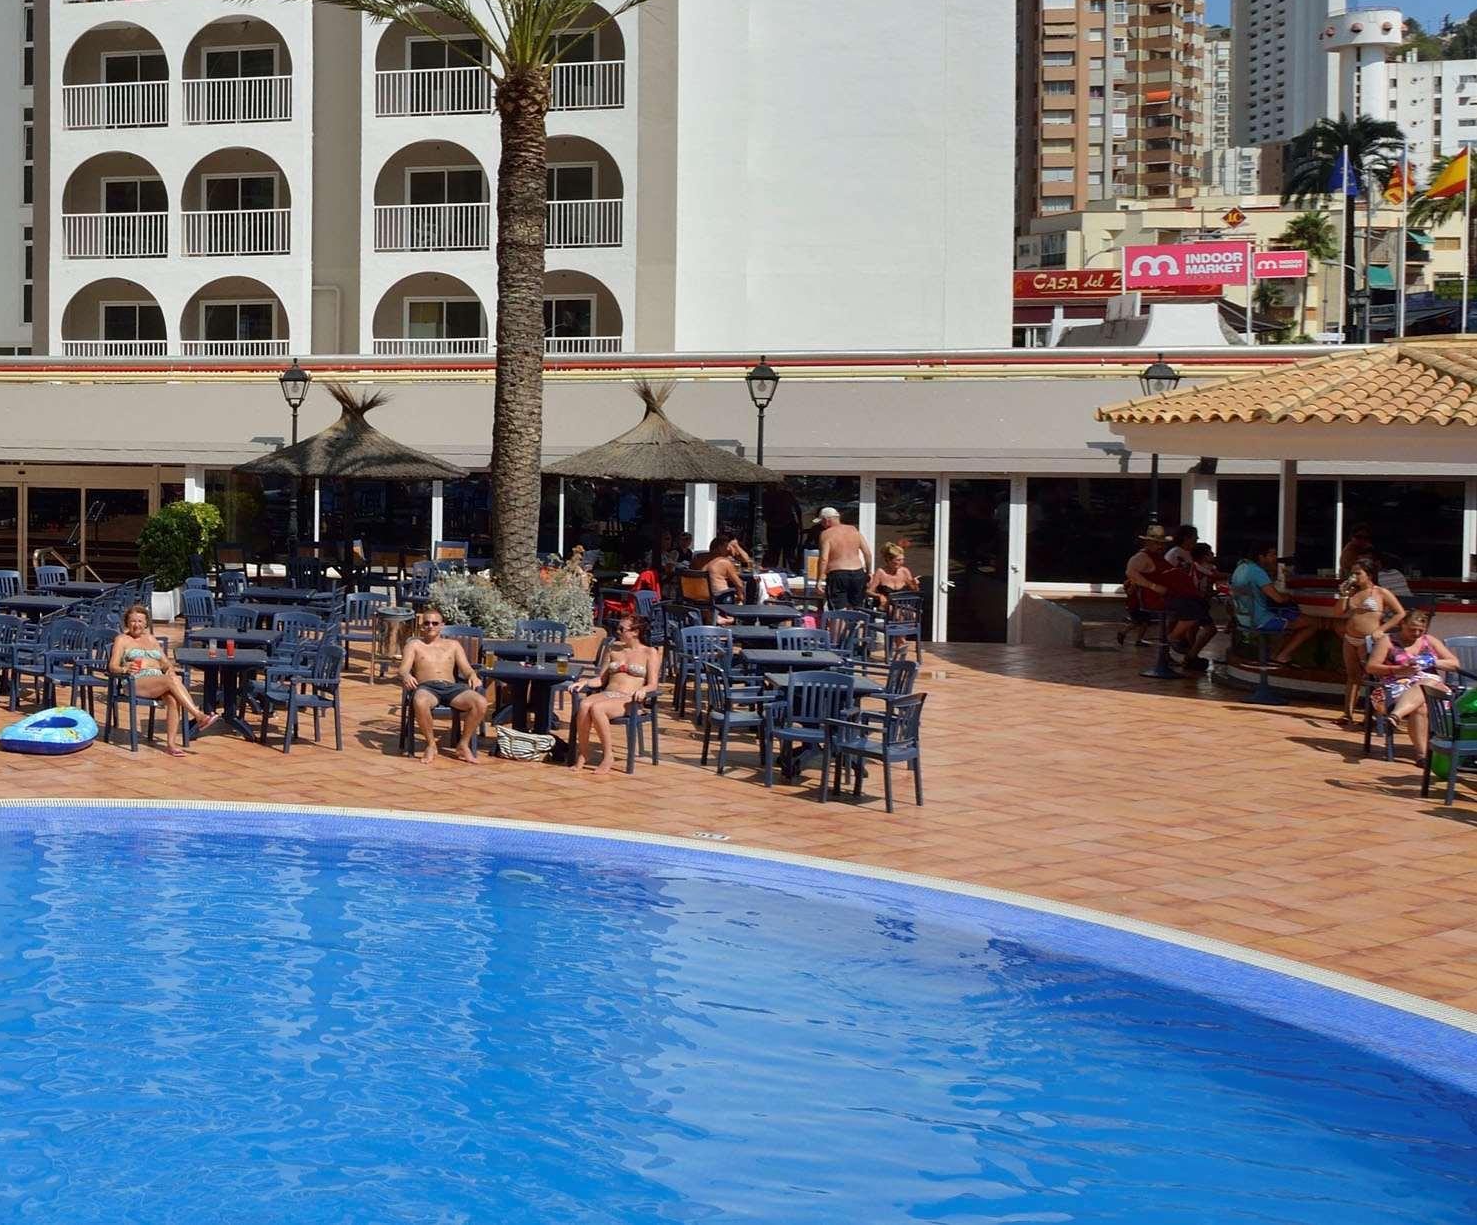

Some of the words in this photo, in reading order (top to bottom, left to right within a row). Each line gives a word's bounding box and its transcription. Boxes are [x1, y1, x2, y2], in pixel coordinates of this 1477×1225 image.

[1185, 252, 1243, 264] INDOOR
[1185, 263, 1243, 275] MARKET
[1033, 273, 1078, 290] CASA
[1083, 274, 1105, 288] del
